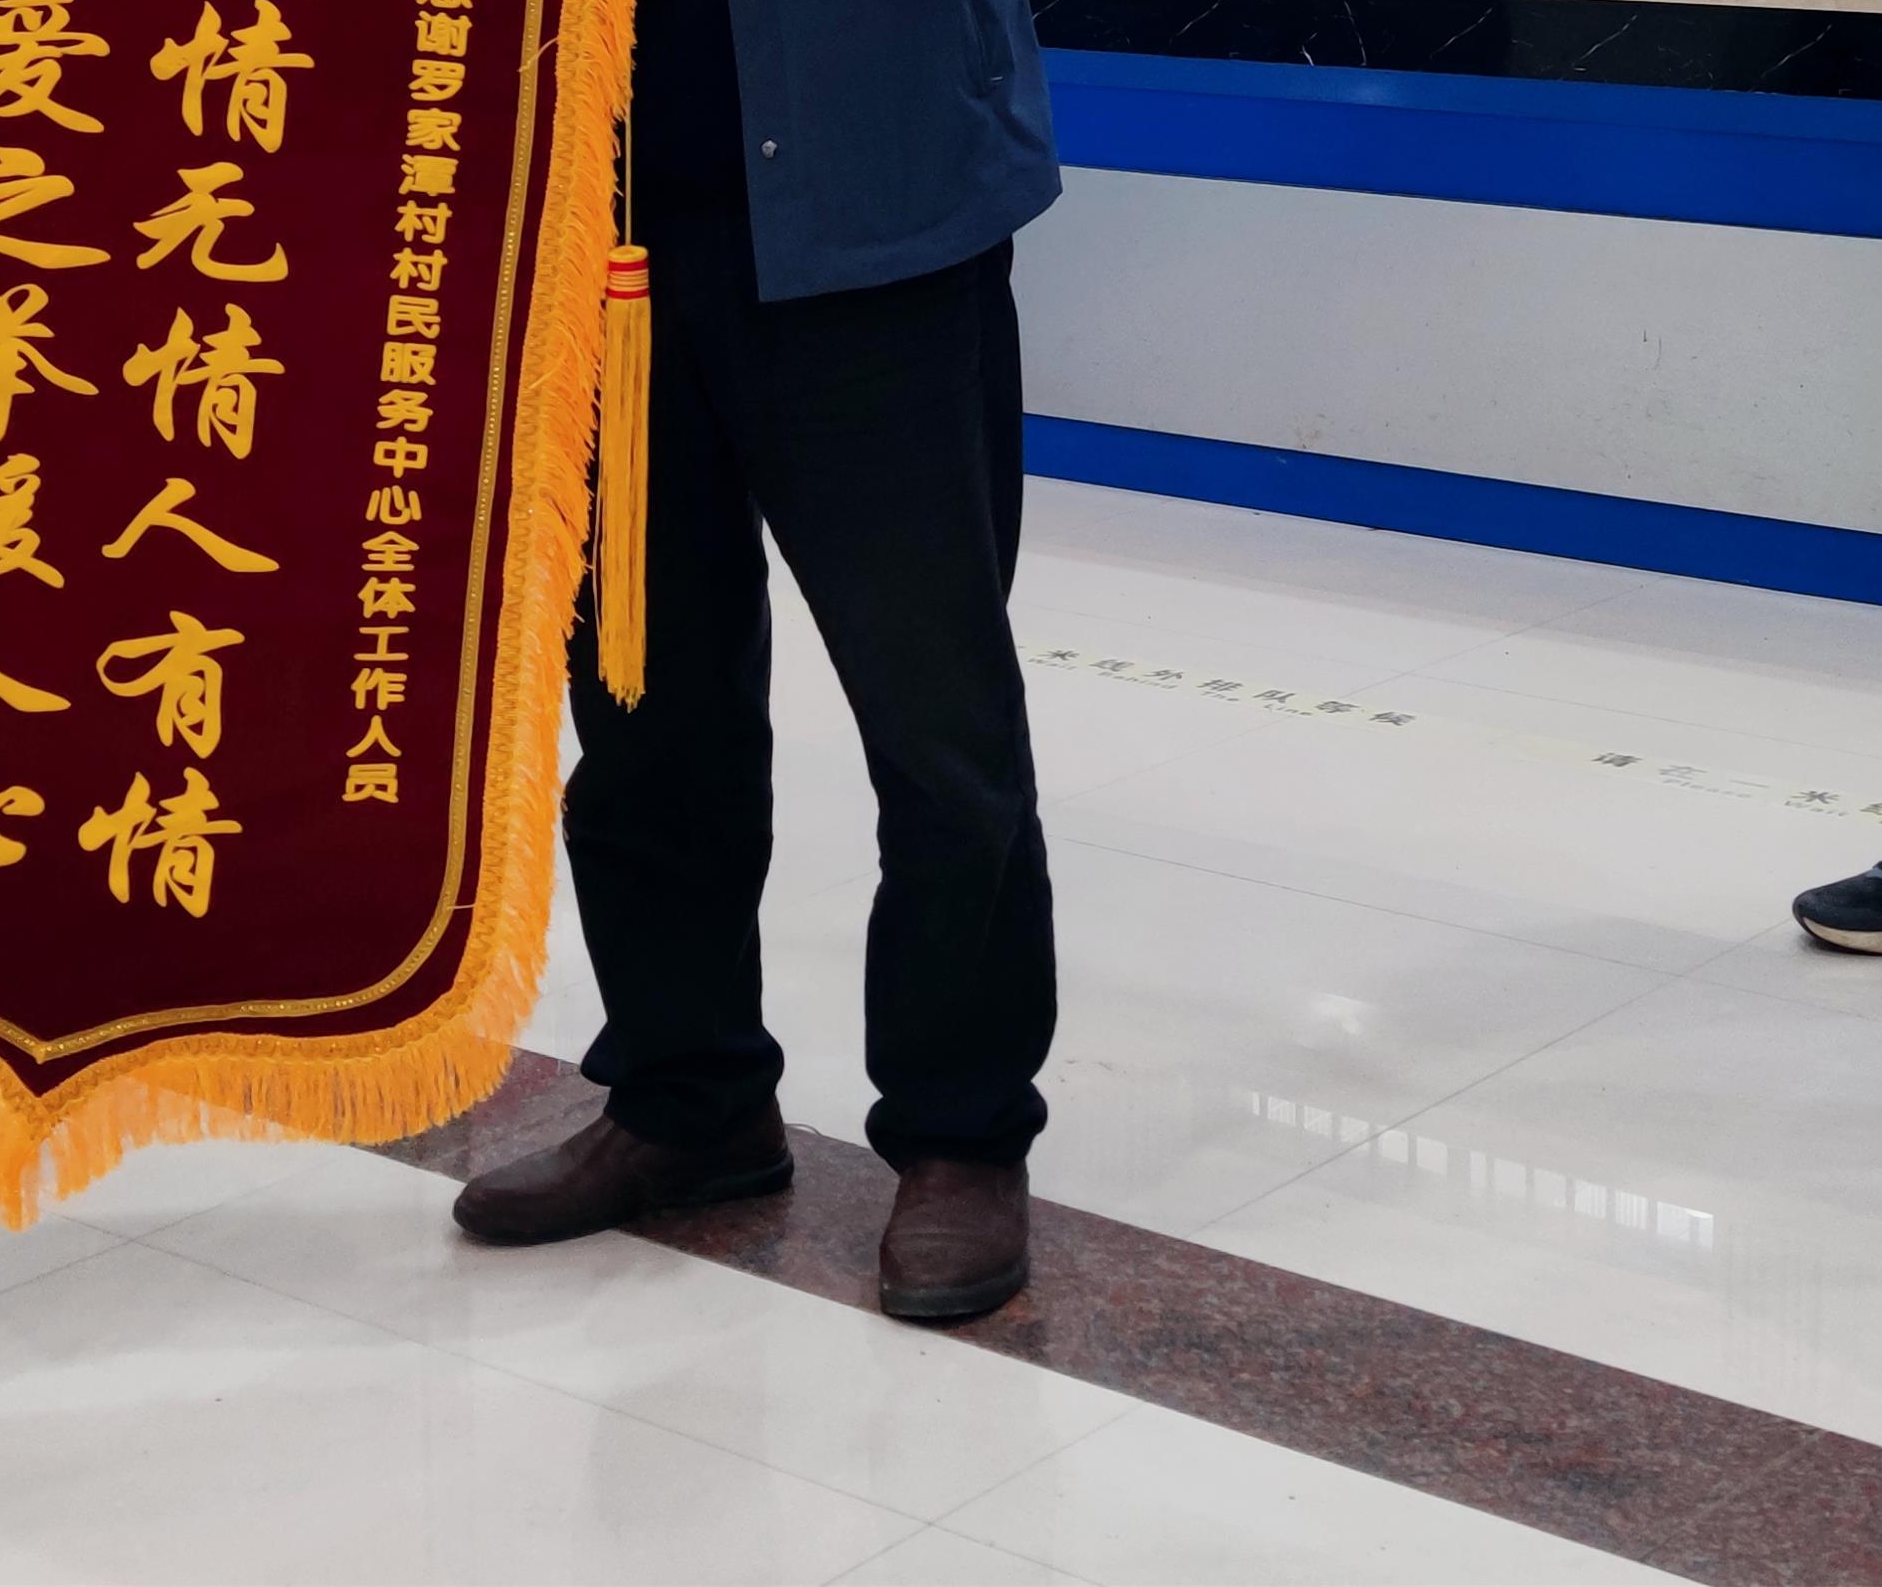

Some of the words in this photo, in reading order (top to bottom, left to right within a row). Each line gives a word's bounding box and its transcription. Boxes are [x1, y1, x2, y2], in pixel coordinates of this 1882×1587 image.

[1018, 645, 1416, 726] 米线外排队等候
